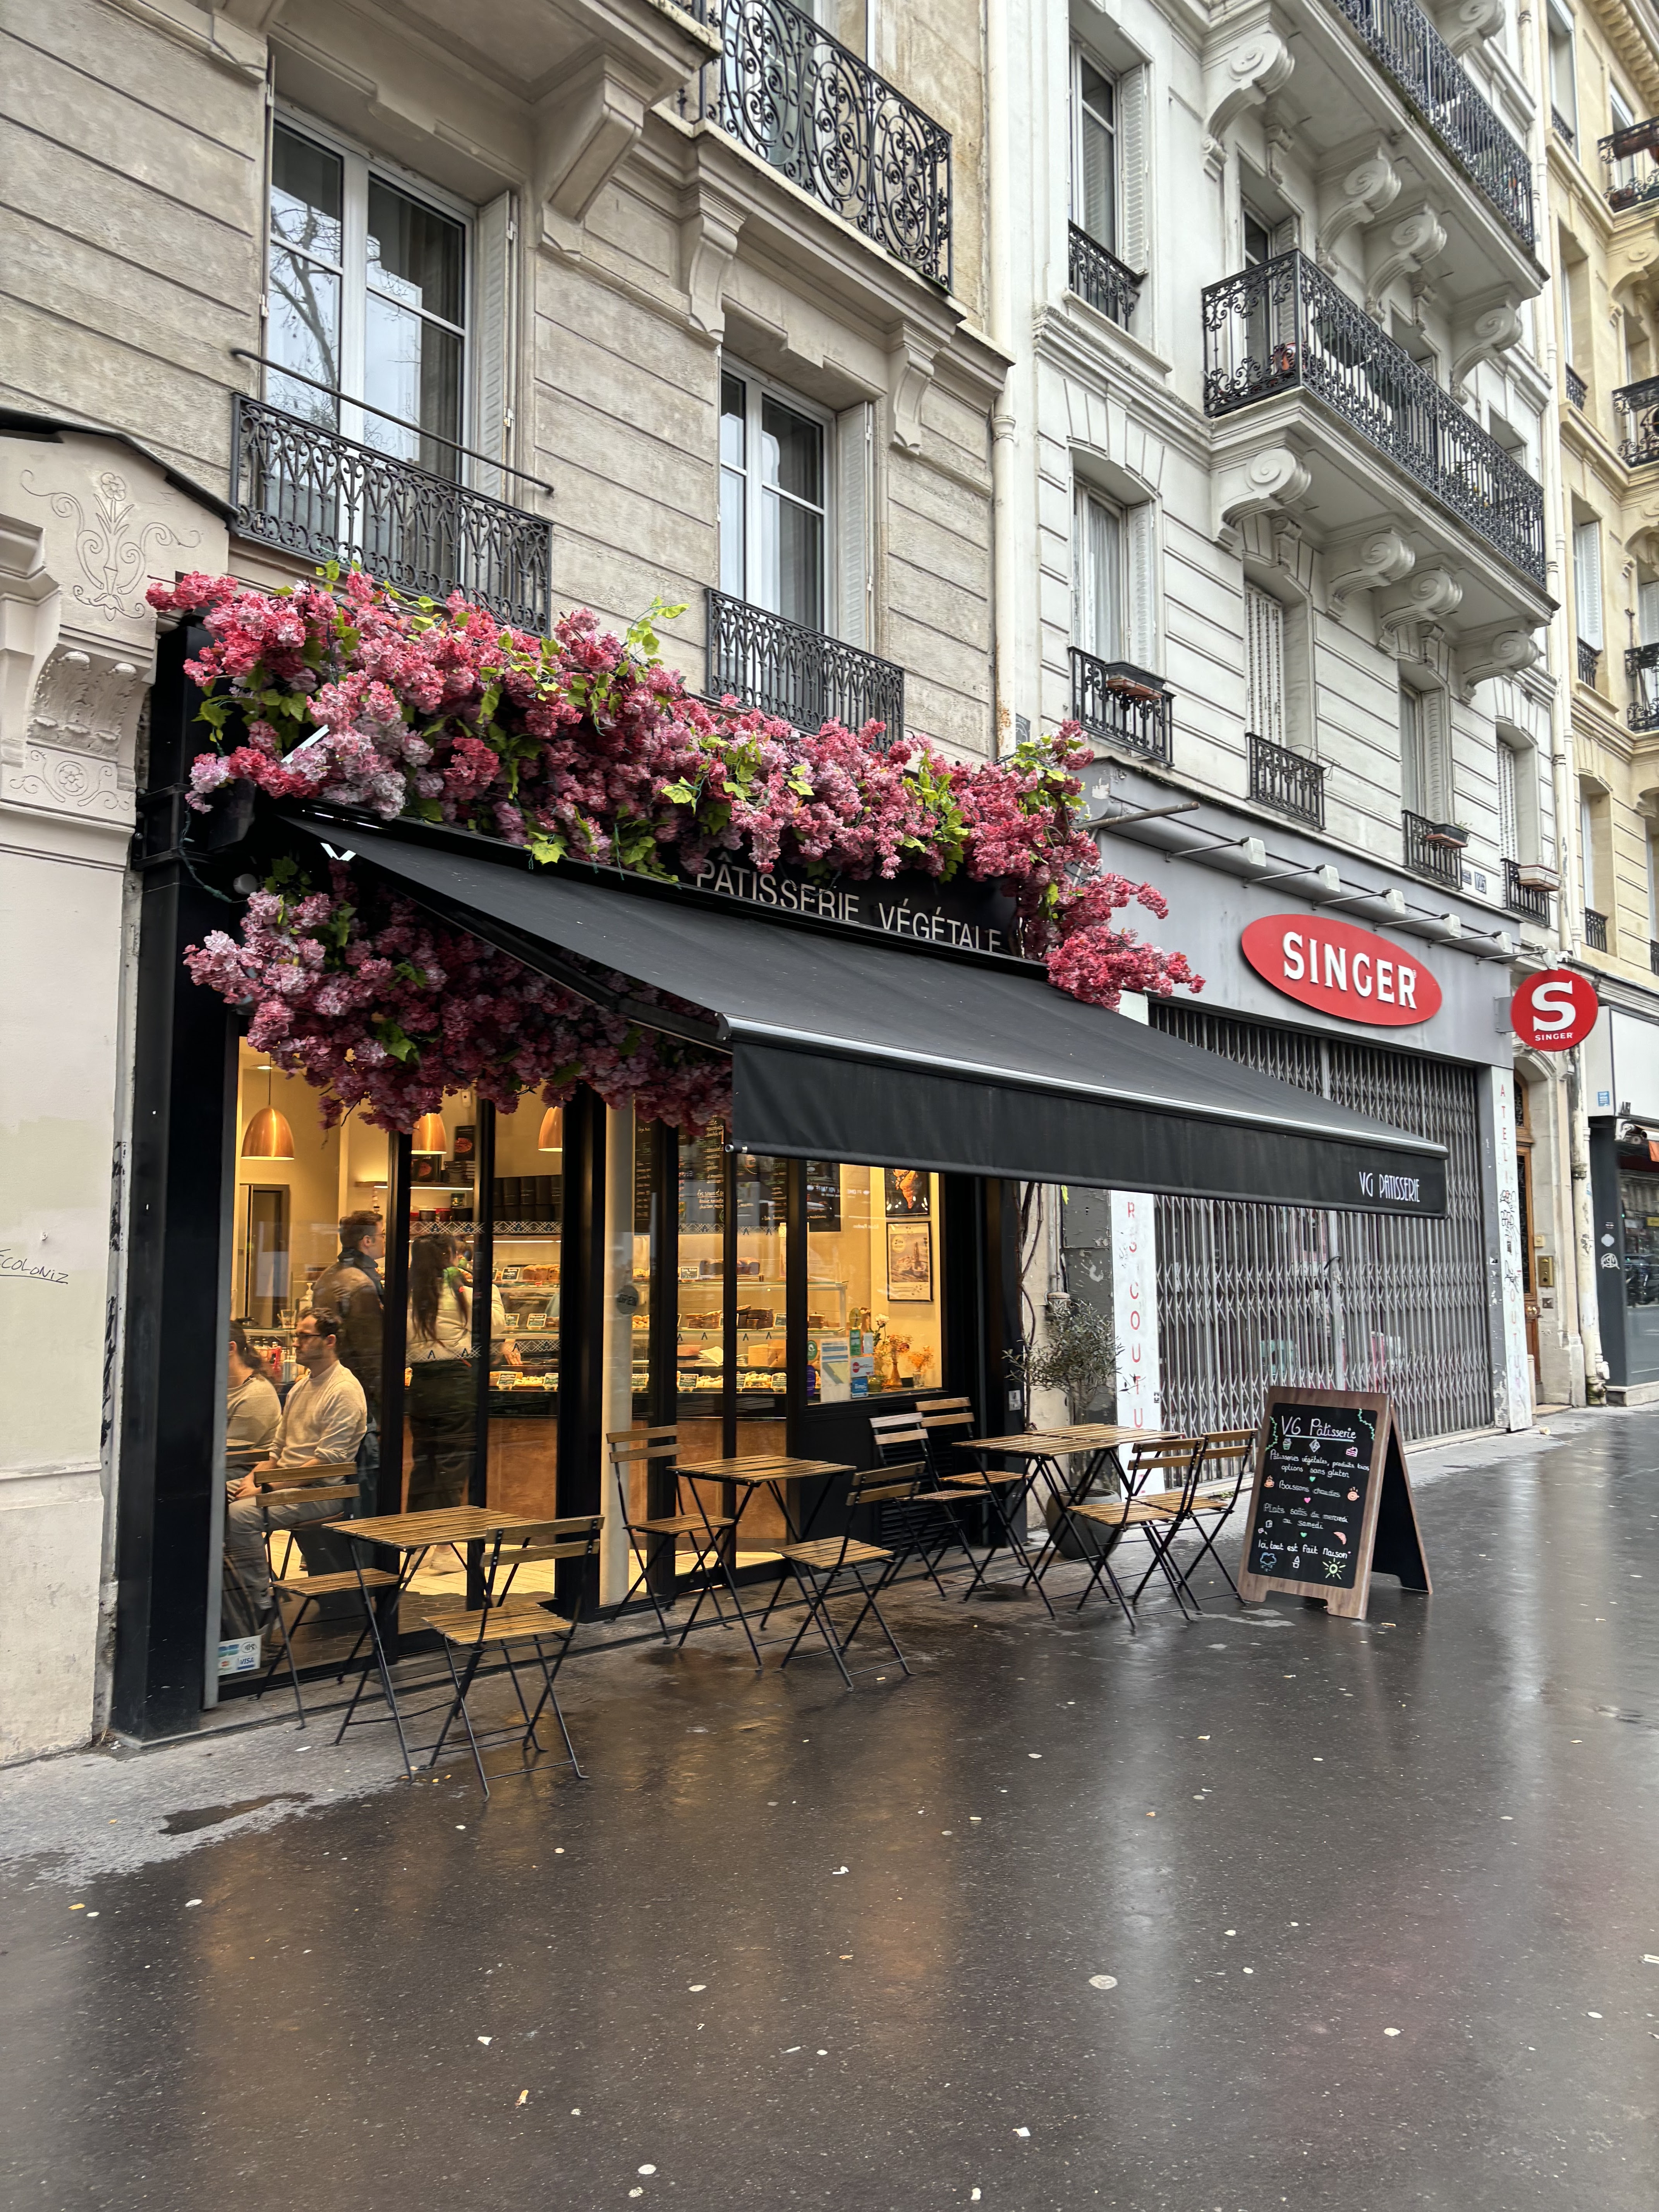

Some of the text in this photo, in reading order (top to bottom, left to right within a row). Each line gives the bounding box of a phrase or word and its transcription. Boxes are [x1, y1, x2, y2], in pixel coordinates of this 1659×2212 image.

[697, 852, 1001, 952] PÂTISSERIE VÉGÉTALE
[1283, 931, 1417, 1009] SINGER
[1532, 980, 1576, 1032] S
[1535, 1032, 1573, 1041] SINGER
[1358, 1171, 1420, 1202] VG PATISSERIE
[1281, 1415, 1357, 1439] VG Pâtisserie
[1281, 1463, 1304, 1472] options
[1328, 1469, 1350, 1478] gluten
[1279, 1480, 1310, 1492] Boissons
[1263, 1503, 1285, 1513] Plats
[1270, 1540, 1284, 1550] tout
[1287, 1543, 1298, 1552] est
[1302, 1544, 1318, 1554] fait
